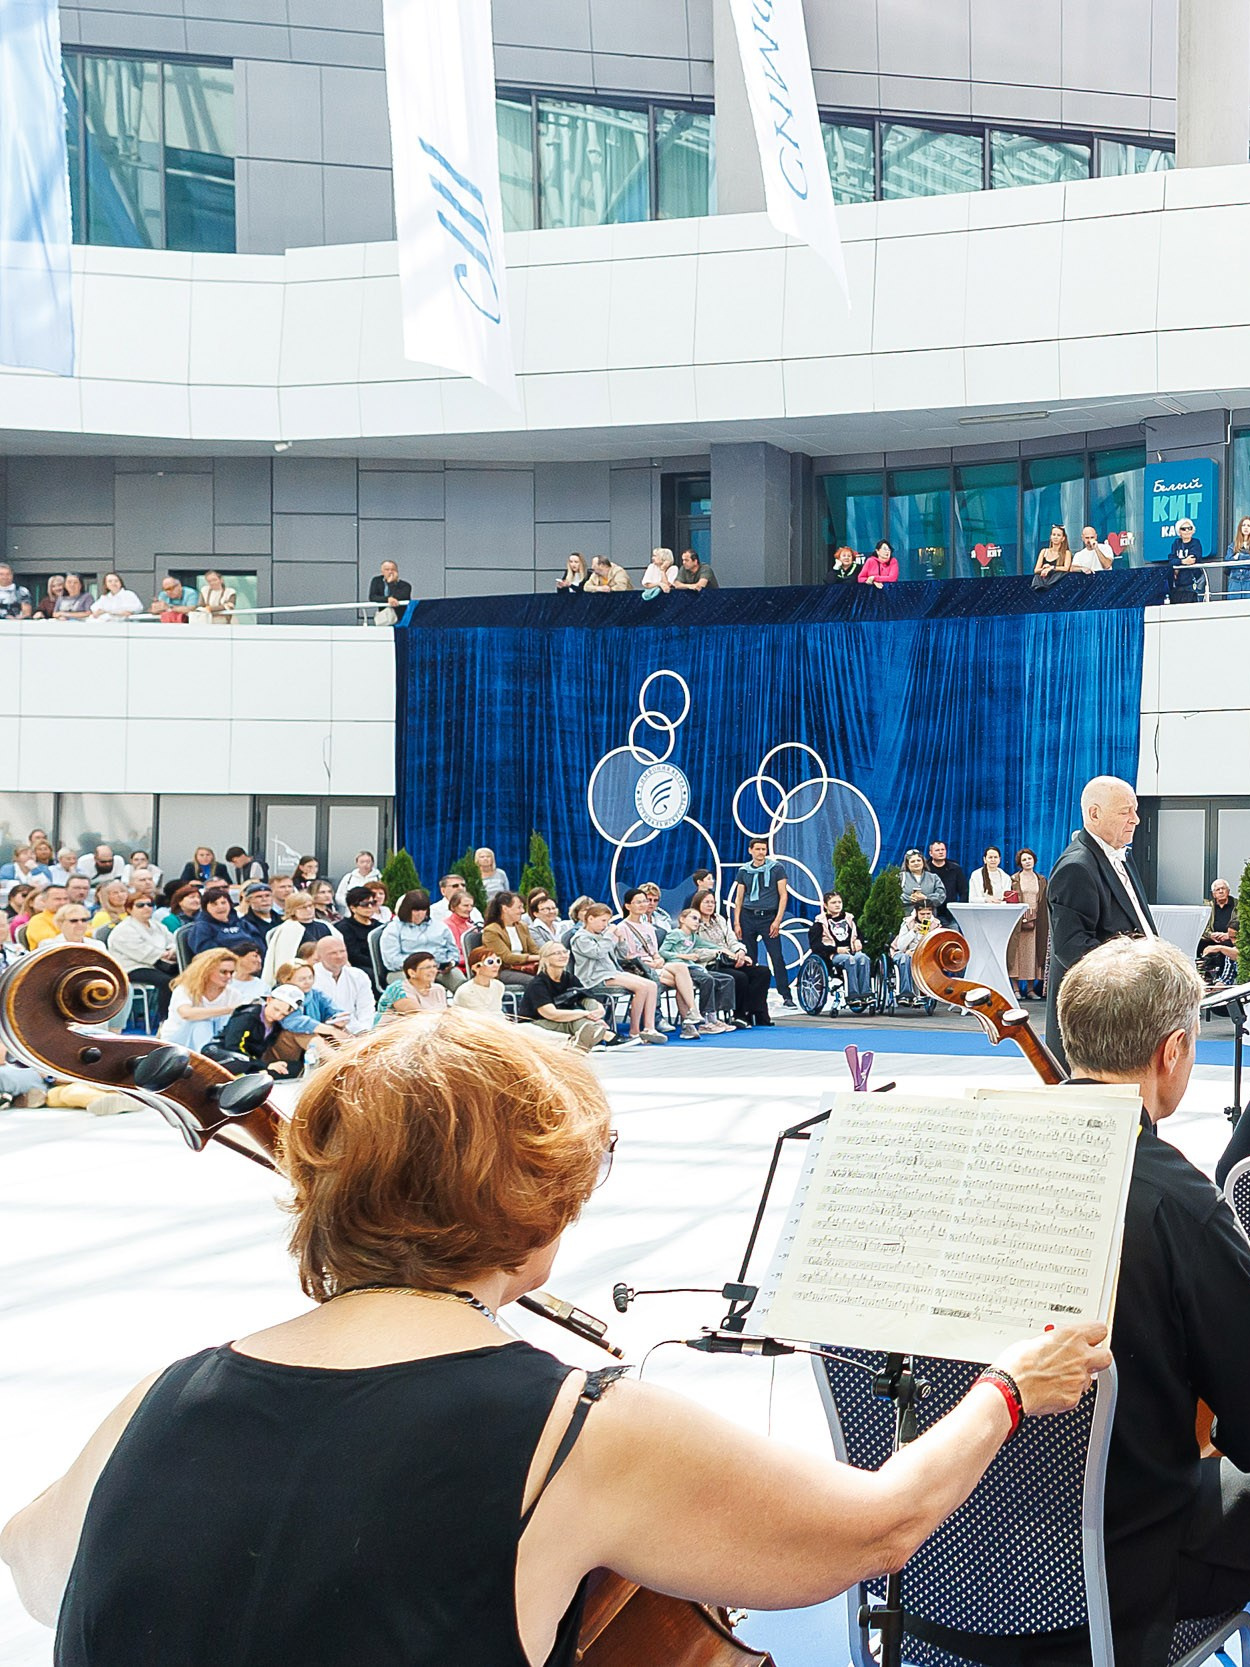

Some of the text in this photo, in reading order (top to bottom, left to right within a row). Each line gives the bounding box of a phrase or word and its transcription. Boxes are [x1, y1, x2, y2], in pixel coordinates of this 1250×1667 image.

[1153, 478, 1203, 493] Белый
[1152, 493, 1203, 523] КИТ
[1161, 525, 1177, 538] КА
